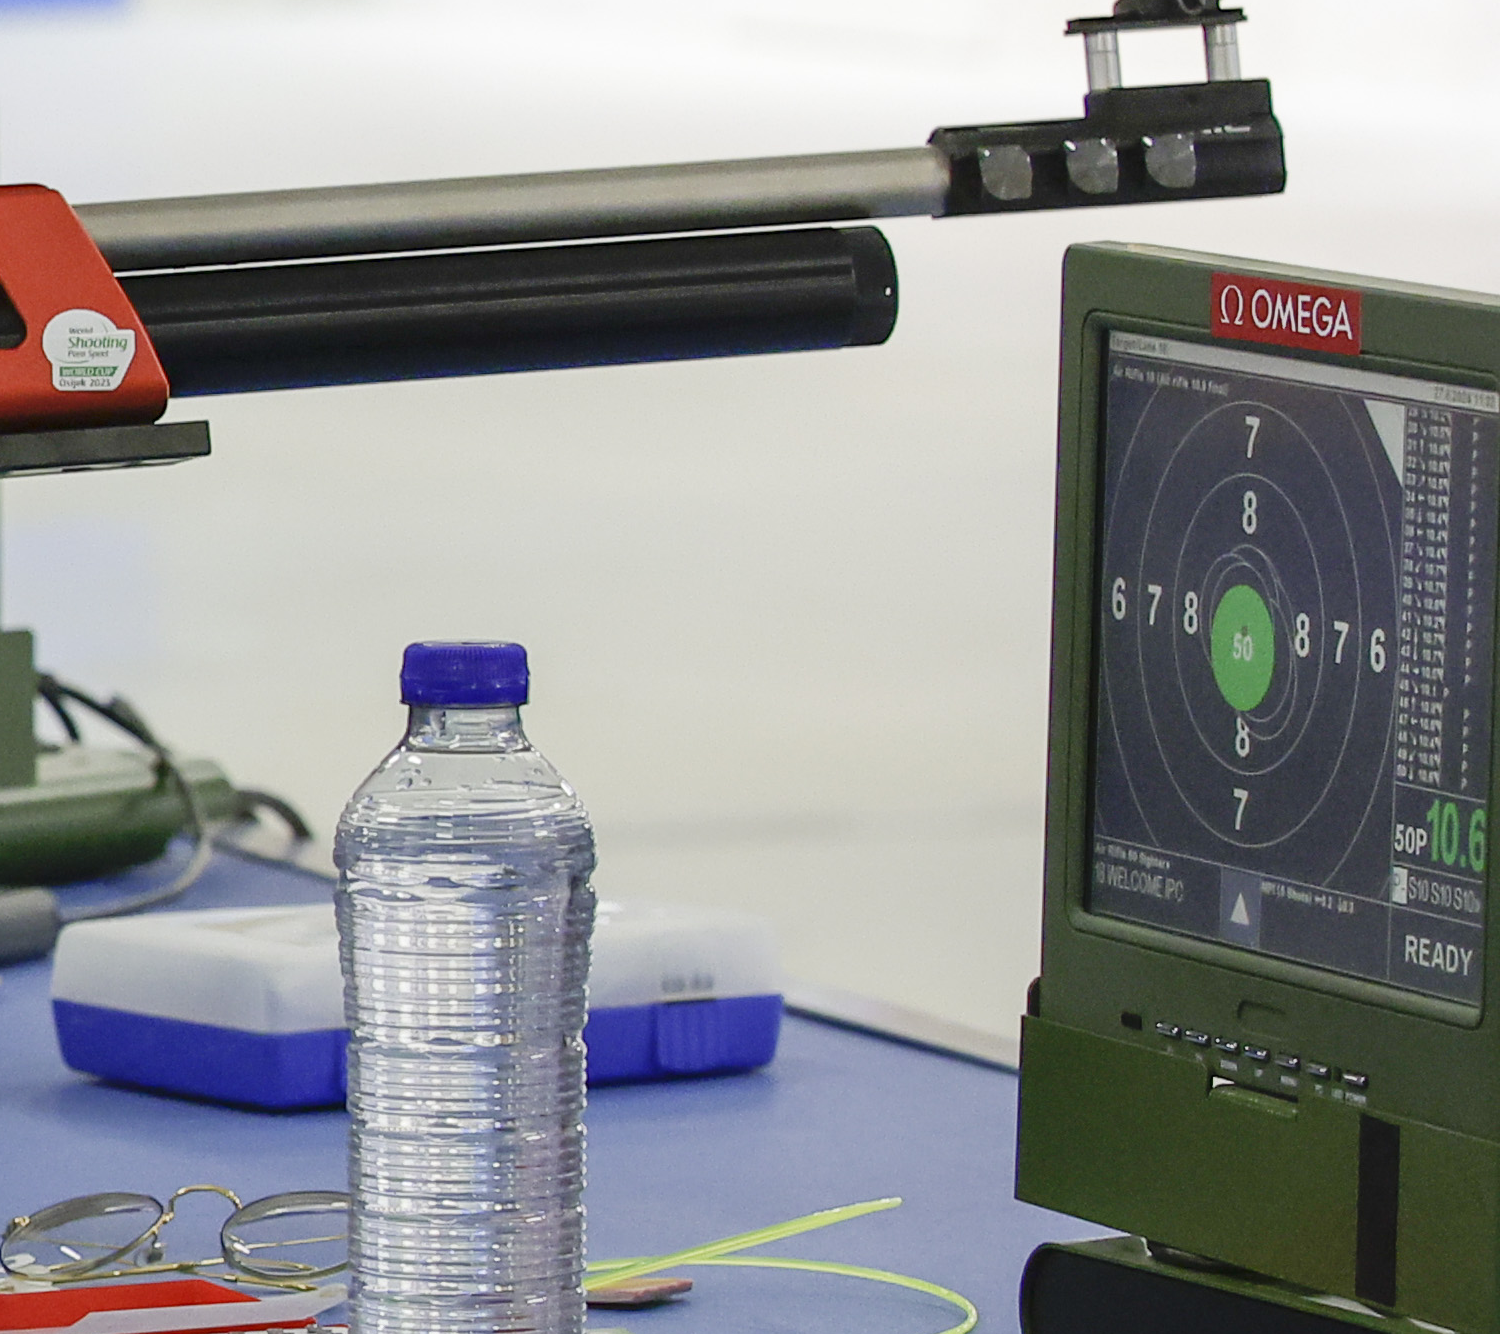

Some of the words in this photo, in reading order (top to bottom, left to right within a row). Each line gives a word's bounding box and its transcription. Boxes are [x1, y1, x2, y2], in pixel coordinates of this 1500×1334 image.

[1251, 289, 1354, 341] OMEGA
[67, 336, 129, 352] Shooting
[1245, 416, 1261, 459] 7
[1242, 490, 1258, 535] 8
[1111, 577, 1127, 621] 6
[1147, 584, 1163, 626] 7
[1183, 591, 1199, 635] 8
[1231, 633, 1254, 662] 50
[1294, 612, 1311, 658] 8
[1333, 620, 1350, 664] 7
[1369, 628, 1387, 673] 6
[1235, 716, 1250, 758] 8
[1232, 788, 1249, 832] 7
[1394, 824, 1428, 855] 50P
[1426, 799, 1487, 872] 10.6
[1107, 863, 1165, 899] WELCOME
[1404, 934, 1473, 976] READY
